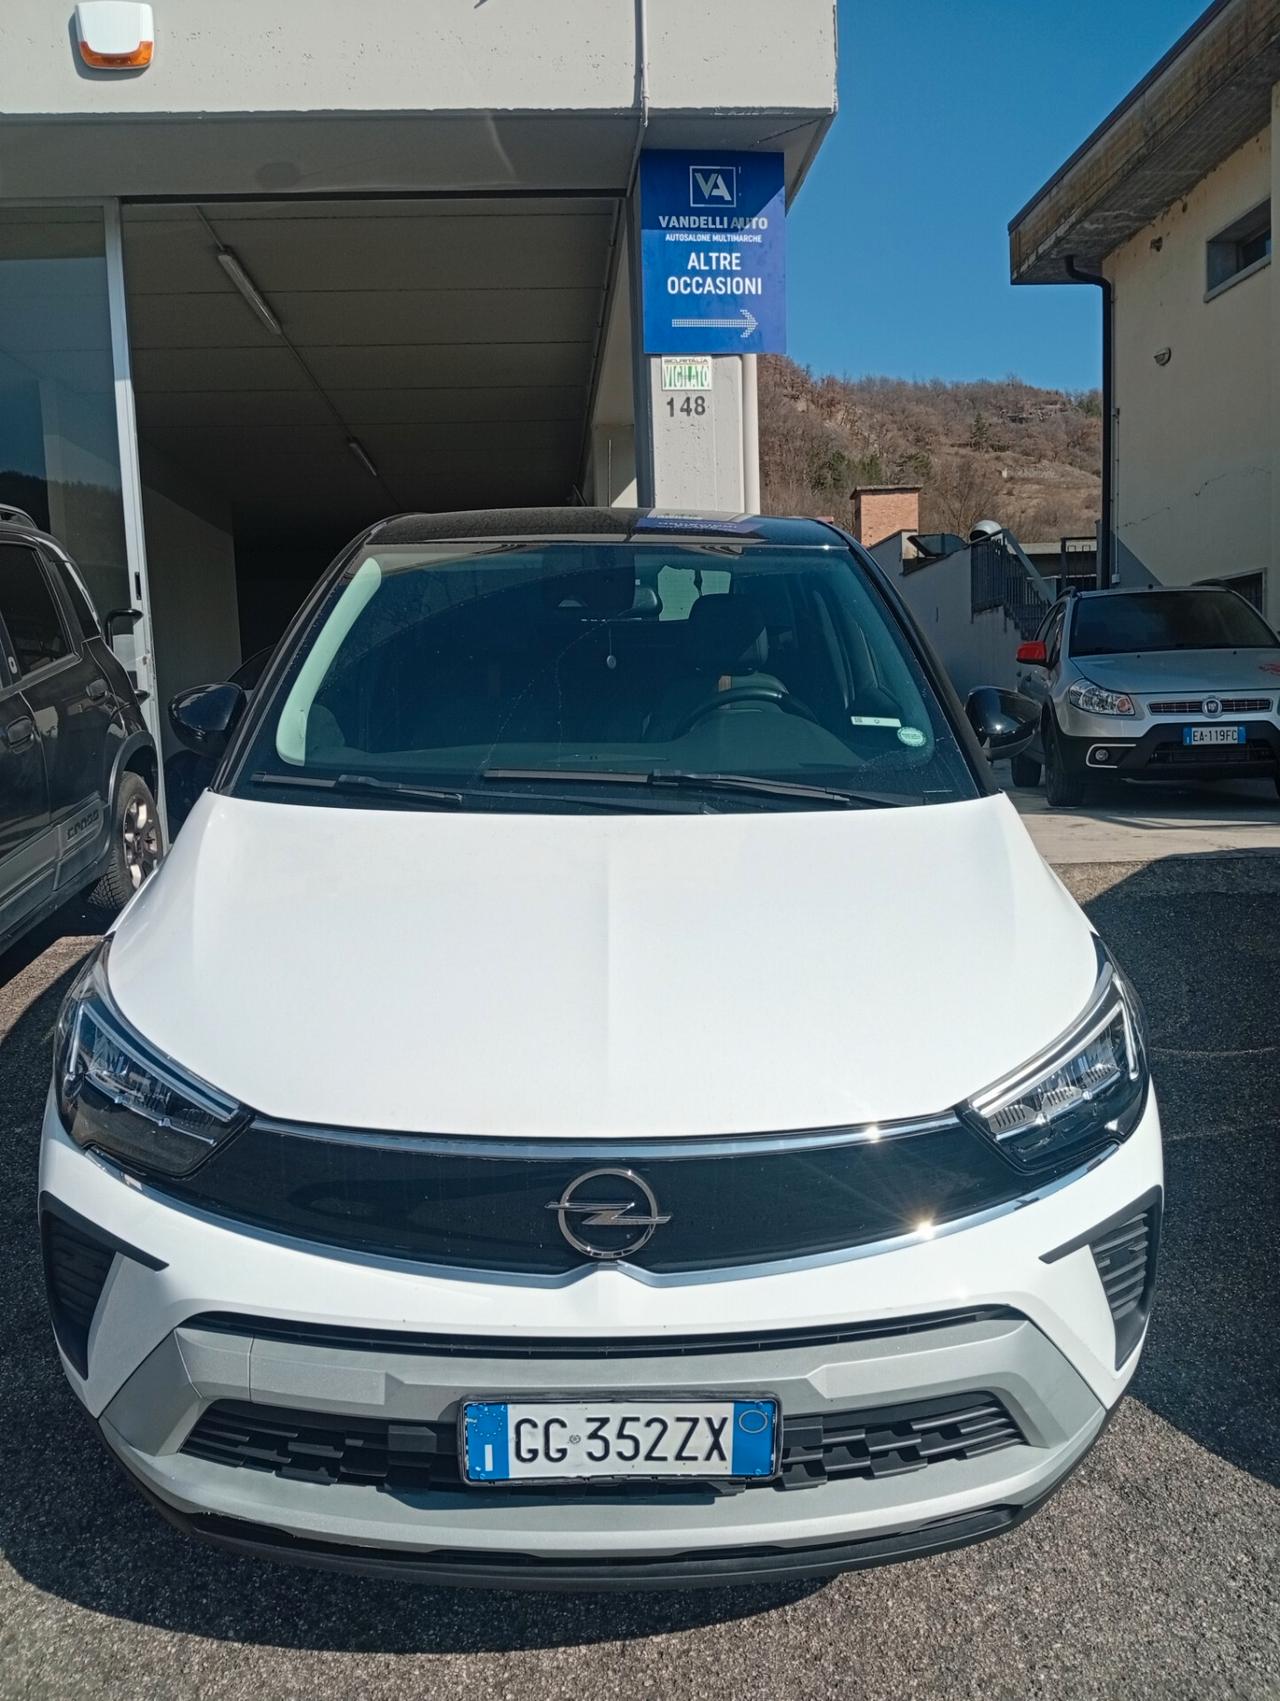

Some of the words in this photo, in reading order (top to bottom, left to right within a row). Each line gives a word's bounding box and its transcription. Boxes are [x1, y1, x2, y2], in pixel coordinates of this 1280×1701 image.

[694, 172, 732, 201] VA
[658, 215, 728, 229] VANDELLI
[730, 216, 769, 230] AUTO
[665, 233, 711, 243] AUTOSALONE
[712, 233, 763, 244] MULTIMARCHE
[687, 251, 742, 271] ALTRE
[667, 276, 762, 295] OCCASIONI
[663, 365, 711, 388] VIGILATO
[666, 395, 706, 418] 148
